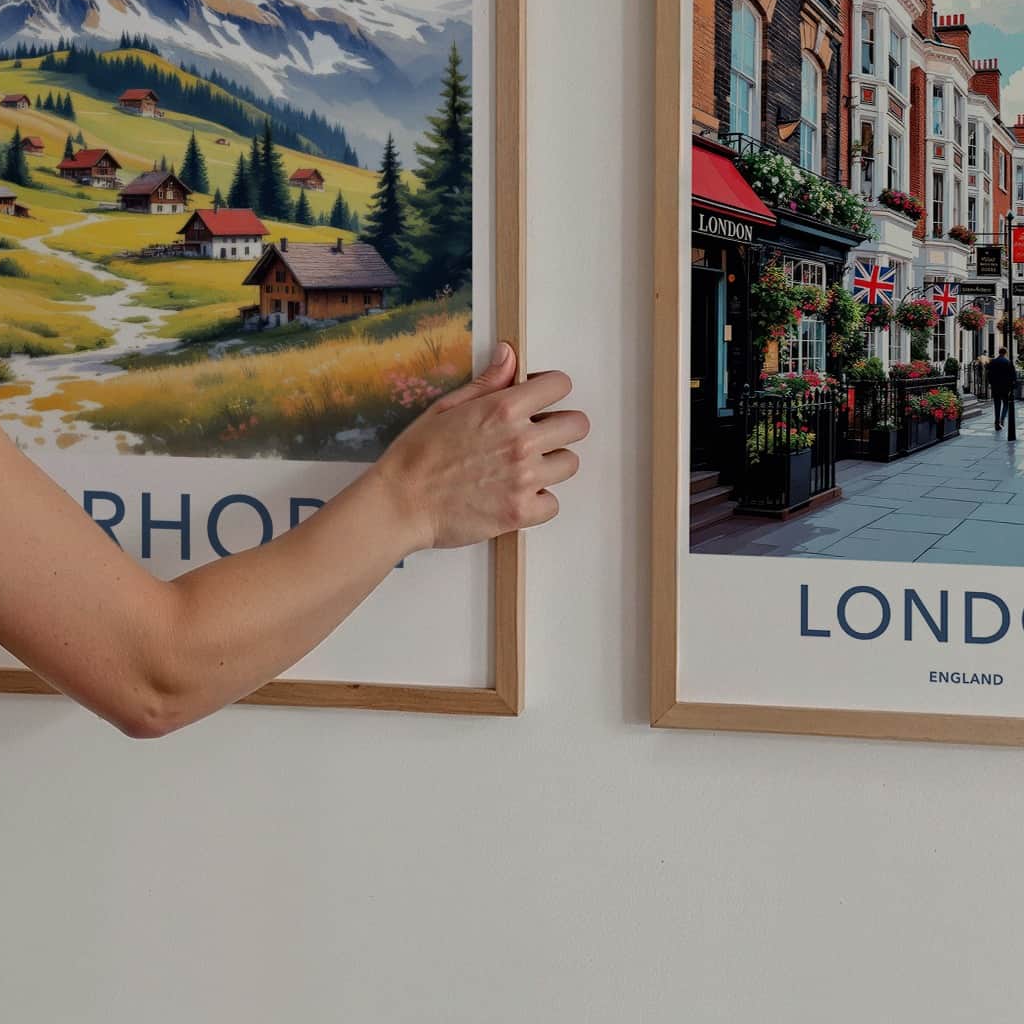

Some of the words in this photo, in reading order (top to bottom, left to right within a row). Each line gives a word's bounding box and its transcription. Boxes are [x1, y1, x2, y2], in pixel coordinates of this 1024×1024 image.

[698, 213, 754, 242] LONDON
[800, 583, 1024, 645] LOND
[929, 670, 1004, 685] ENGLAND
